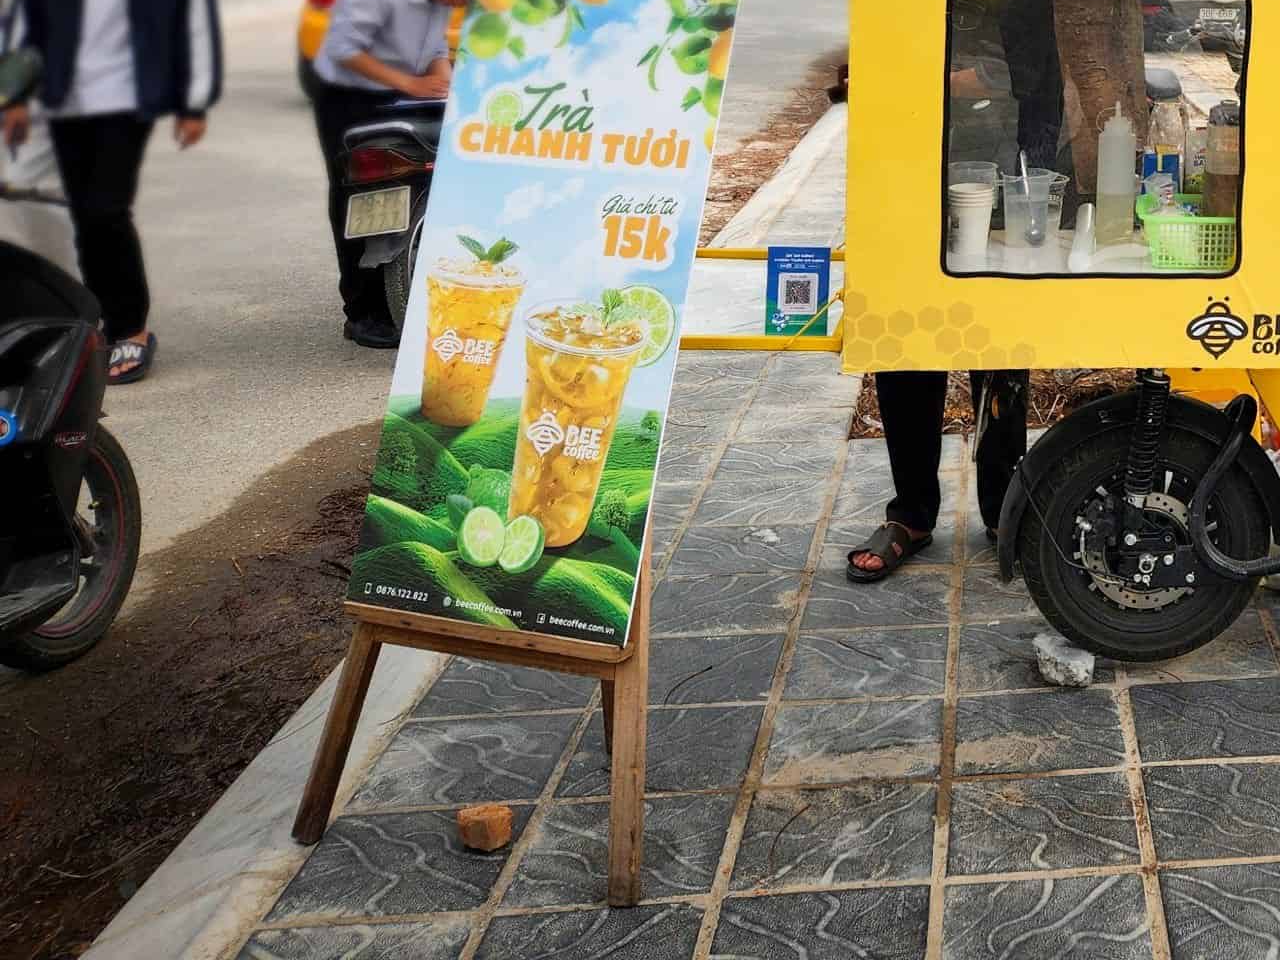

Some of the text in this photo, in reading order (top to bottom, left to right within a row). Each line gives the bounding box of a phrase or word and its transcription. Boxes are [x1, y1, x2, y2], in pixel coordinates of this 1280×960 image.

[514, 82, 594, 132] Trà
[459, 122, 691, 169] CHANH TƯƠI
[602, 194, 635, 219] Giá
[603, 214, 671, 262] 15k
[463, 338, 496, 355] BEE
[565, 424, 604, 448] BEE
[562, 443, 600, 460] coffee
[455, 599, 522, 618] beecoffee.com.vn
[548, 615, 615, 635] beecoffee.com.vn
